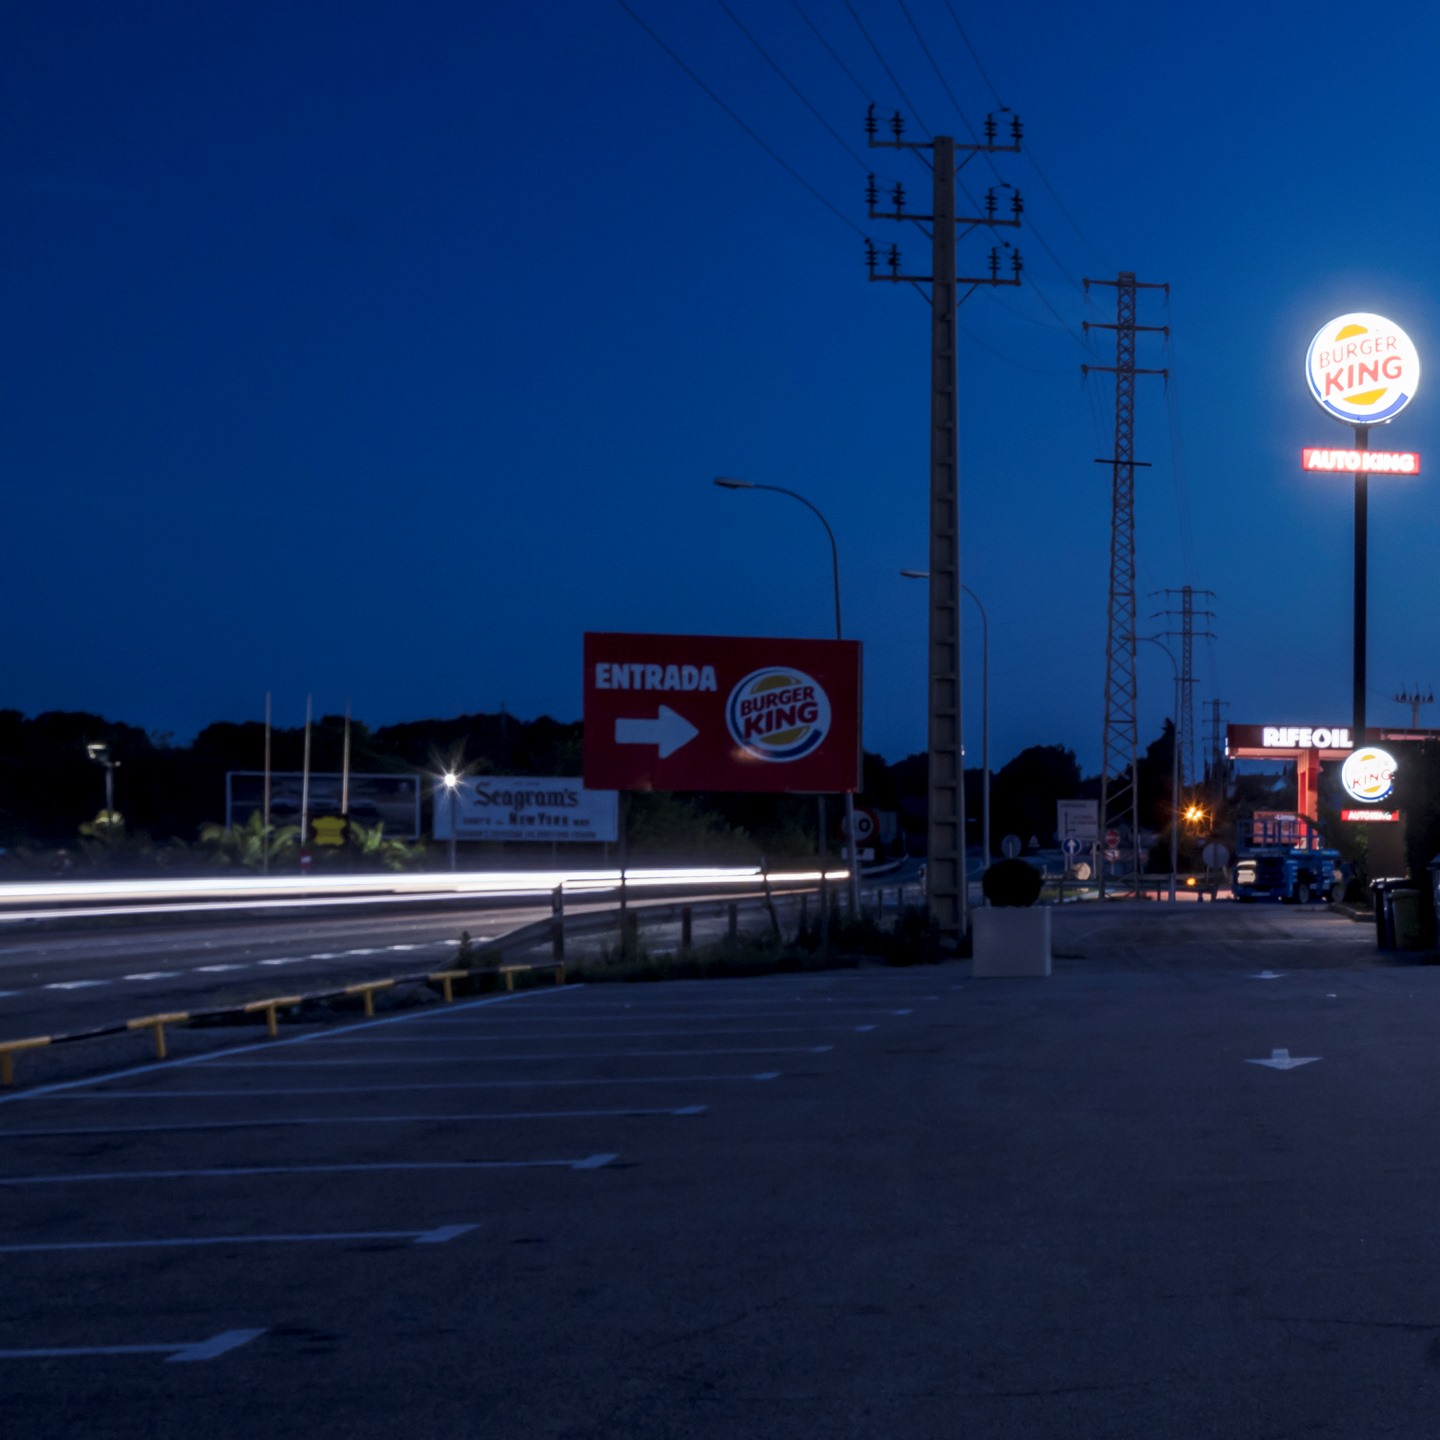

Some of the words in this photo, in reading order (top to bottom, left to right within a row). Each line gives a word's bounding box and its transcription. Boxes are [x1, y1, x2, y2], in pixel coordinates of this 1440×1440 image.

[1319, 335, 1397, 369] BURGER
[1325, 356, 1402, 397] KING
[595, 662, 718, 692] ENTRADA
[739, 685, 815, 717] BURGER
[743, 702, 818, 741] KING
[473, 782, 579, 810] Seagram's
